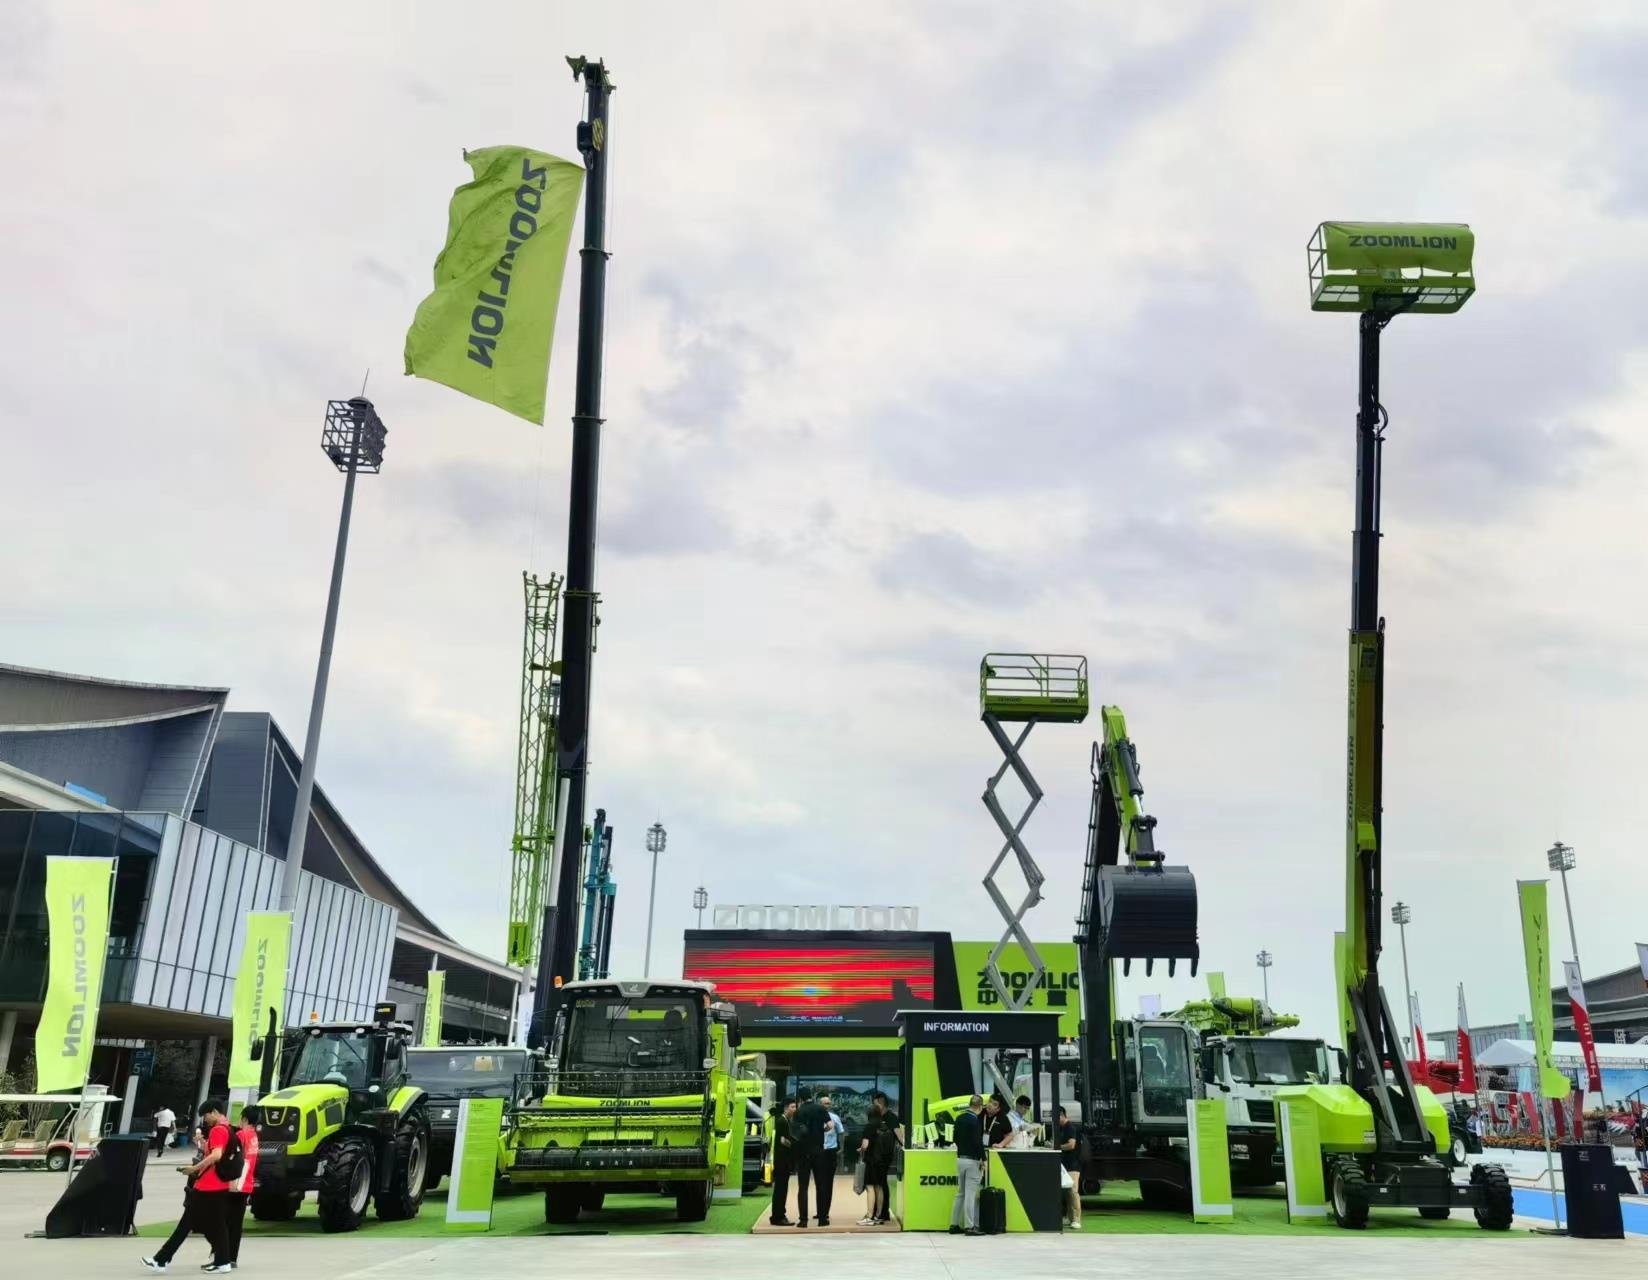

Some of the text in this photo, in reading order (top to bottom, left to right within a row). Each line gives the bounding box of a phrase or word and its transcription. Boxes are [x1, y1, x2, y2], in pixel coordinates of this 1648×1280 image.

[1348, 234, 1457, 250] ZOOMLION
[714, 904, 919, 931] ZOOMLION
[922, 1021, 990, 1033] INFORMATION
[599, 1099, 651, 1107] ZOOMLION
